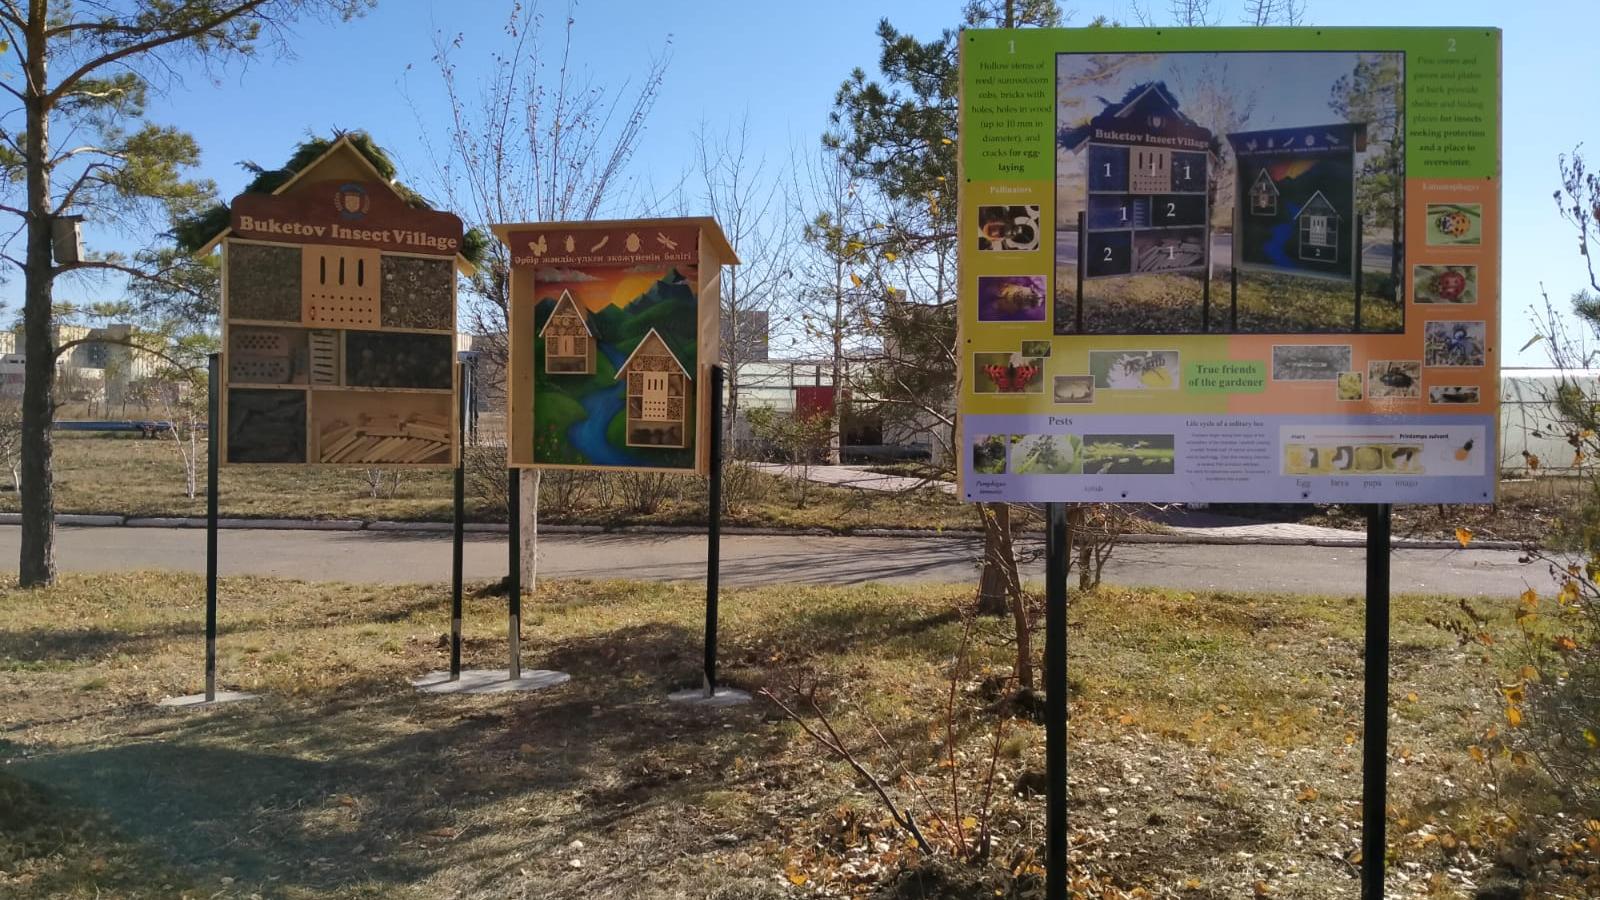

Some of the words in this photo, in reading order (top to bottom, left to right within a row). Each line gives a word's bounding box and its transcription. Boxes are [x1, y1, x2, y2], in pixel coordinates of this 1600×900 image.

[1009, 40, 1016, 54] 1
[1447, 39, 1456, 52] 2
[1027, 90, 1045, 98] with
[1440, 114, 1452, 122] for
[996, 120, 1004, 128] to
[1035, 120, 1043, 128] in
[1025, 134, 1040, 142] and
[1095, 128, 1144, 142] Buketov
[1146, 134, 1176, 145] Insect
[1444, 129, 1485, 138] protection
[982, 149, 1007, 157] cracks
[1010, 149, 1021, 157] for
[1419, 144, 1437, 152] and
[1444, 144, 1465, 153] place
[1468, 144, 1476, 152] to
[998, 164, 1024, 172] laying
[1104, 165, 1112, 177] 1
[1184, 166, 1192, 180] 1
[1120, 207, 1128, 220] 1
[1167, 203, 1176, 217] 2
[239, 215, 326, 237] Buketov
[331, 224, 391, 242] Insect
[391, 230, 458, 250] Village
[1104, 247, 1112, 261] 2
[1197, 364, 1220, 374] True
[1222, 364, 1256, 374] friends
[1188, 378, 1198, 386] of
[1200, 378, 1216, 386] the
[1218, 378, 1264, 388] gardener
[1048, 416, 1073, 426] Pests
